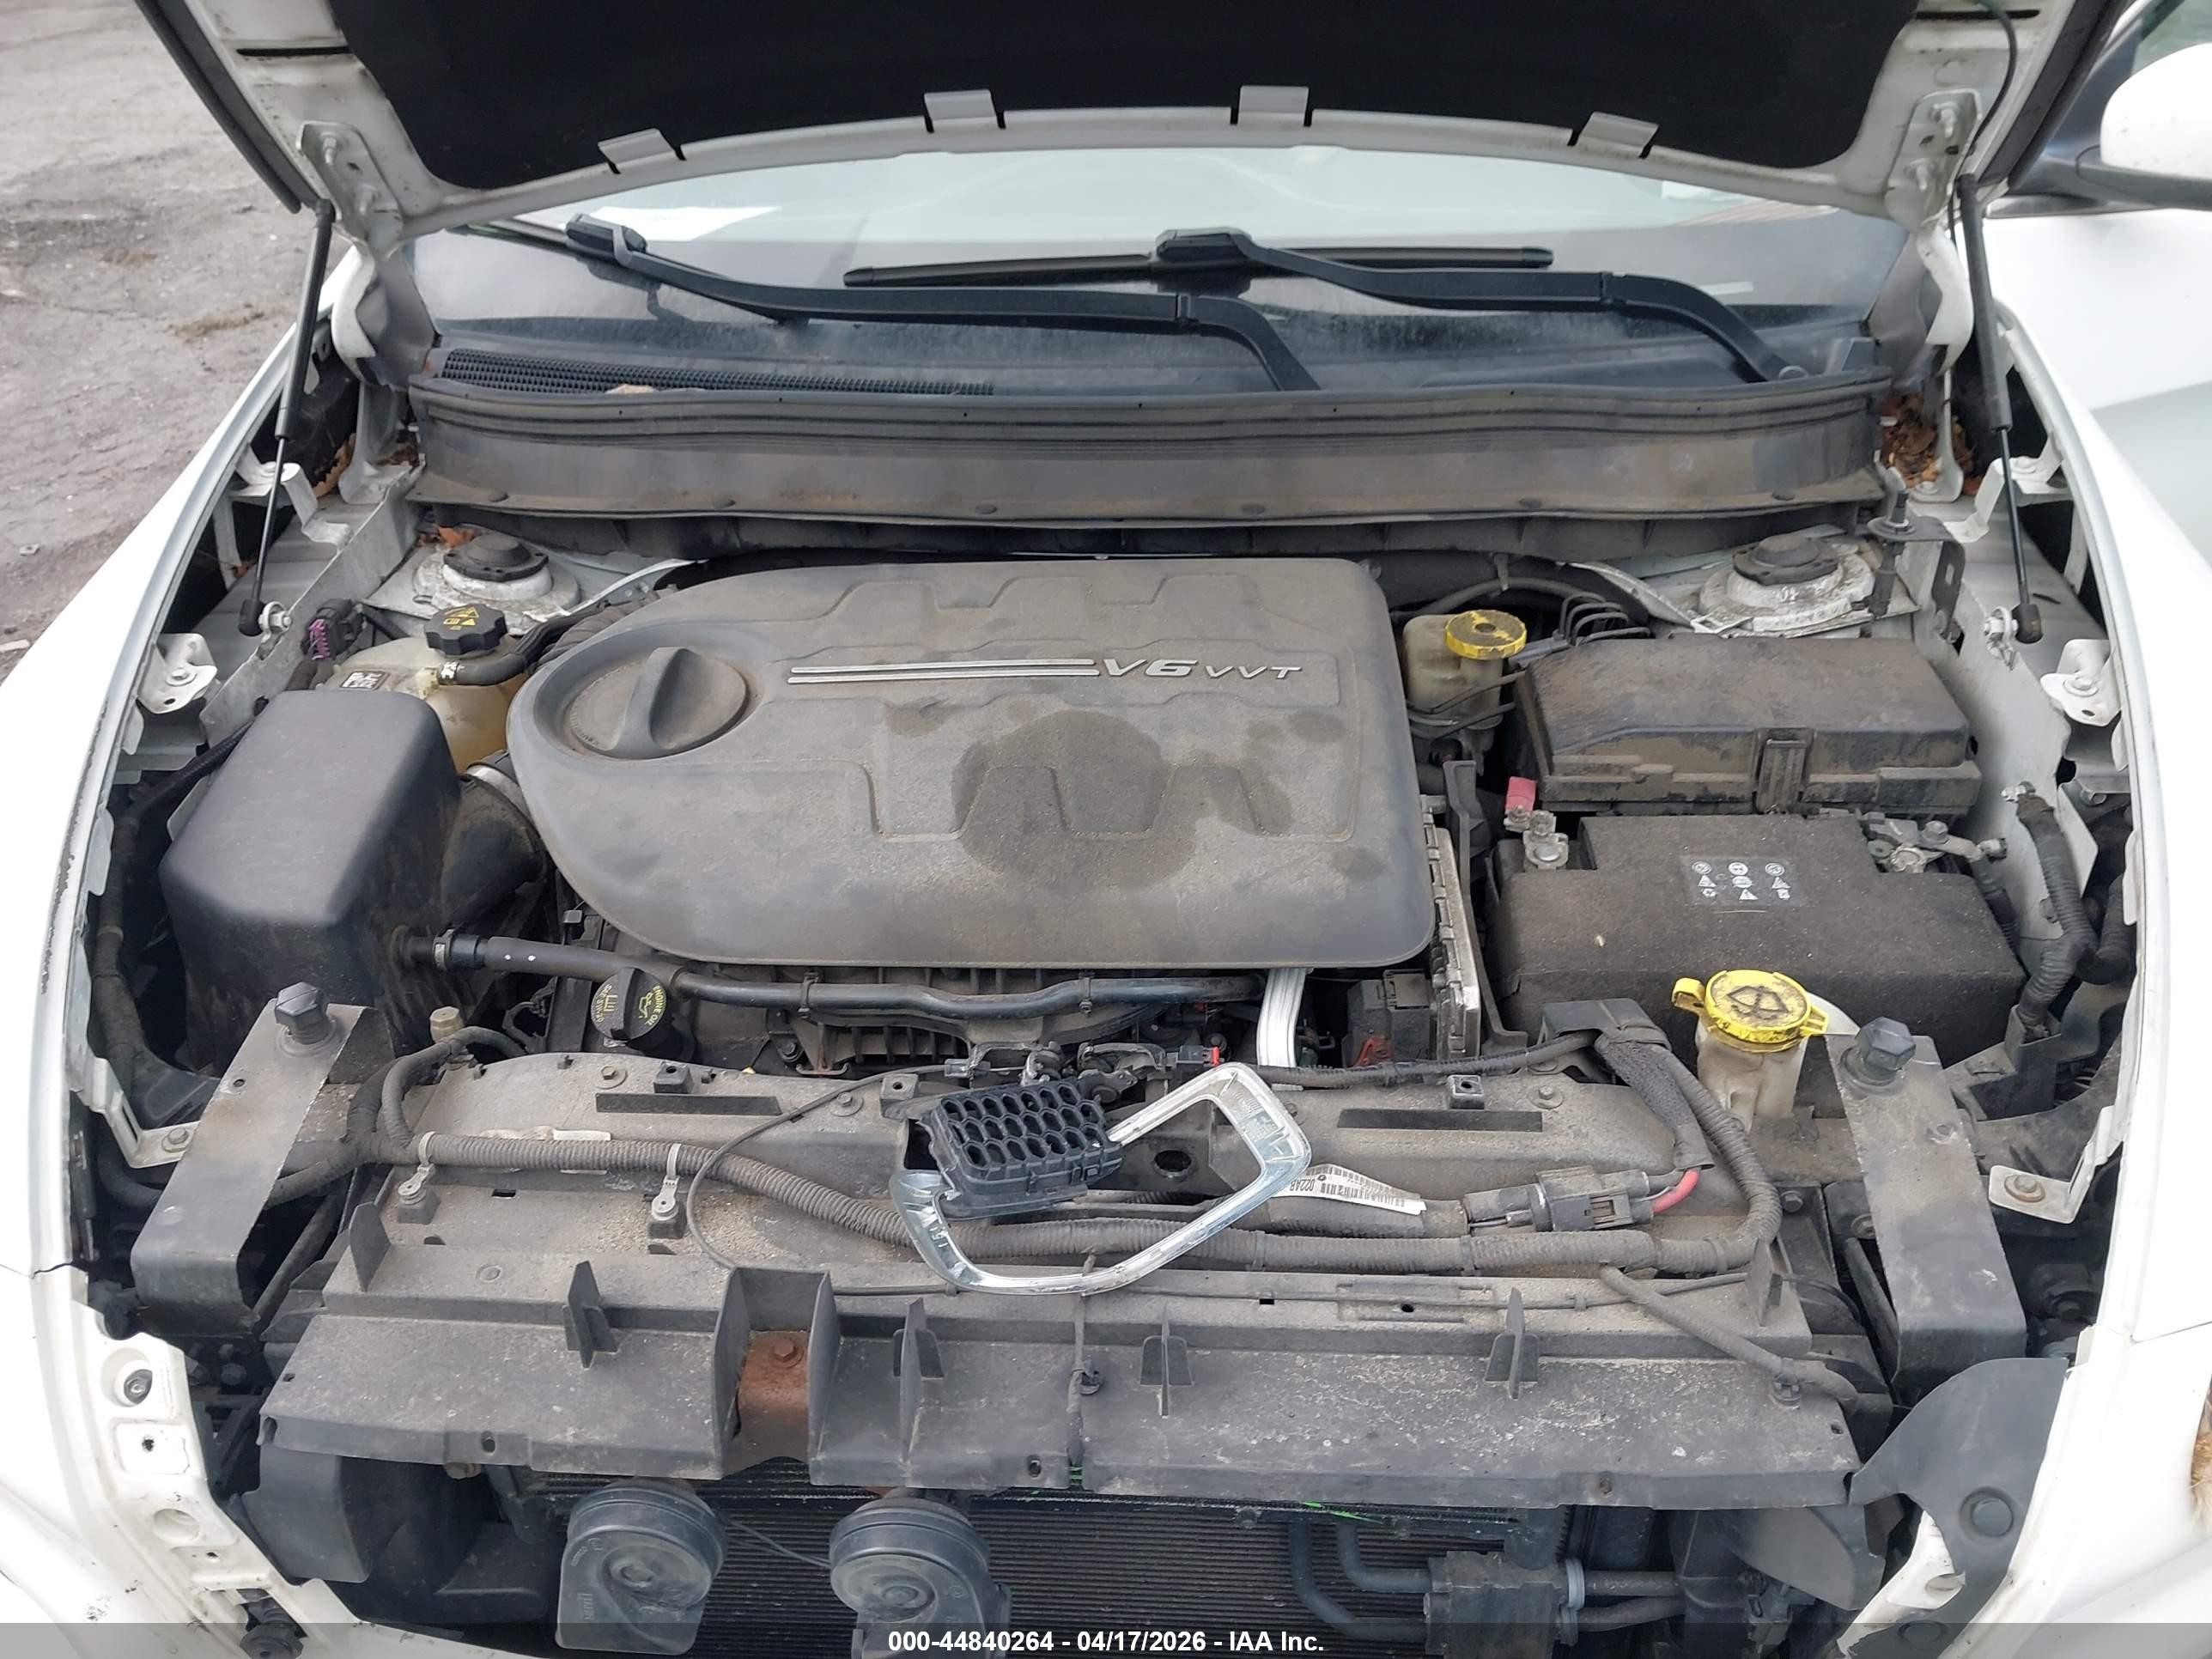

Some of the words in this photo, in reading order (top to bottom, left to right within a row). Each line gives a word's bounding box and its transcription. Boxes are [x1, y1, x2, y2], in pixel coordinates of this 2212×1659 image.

[1103, 659, 1199, 677] V6
[1205, 665, 1302, 679] VVT
[653, 985, 664, 1013] ENGINE
[645, 1014, 659, 1026] OIL
